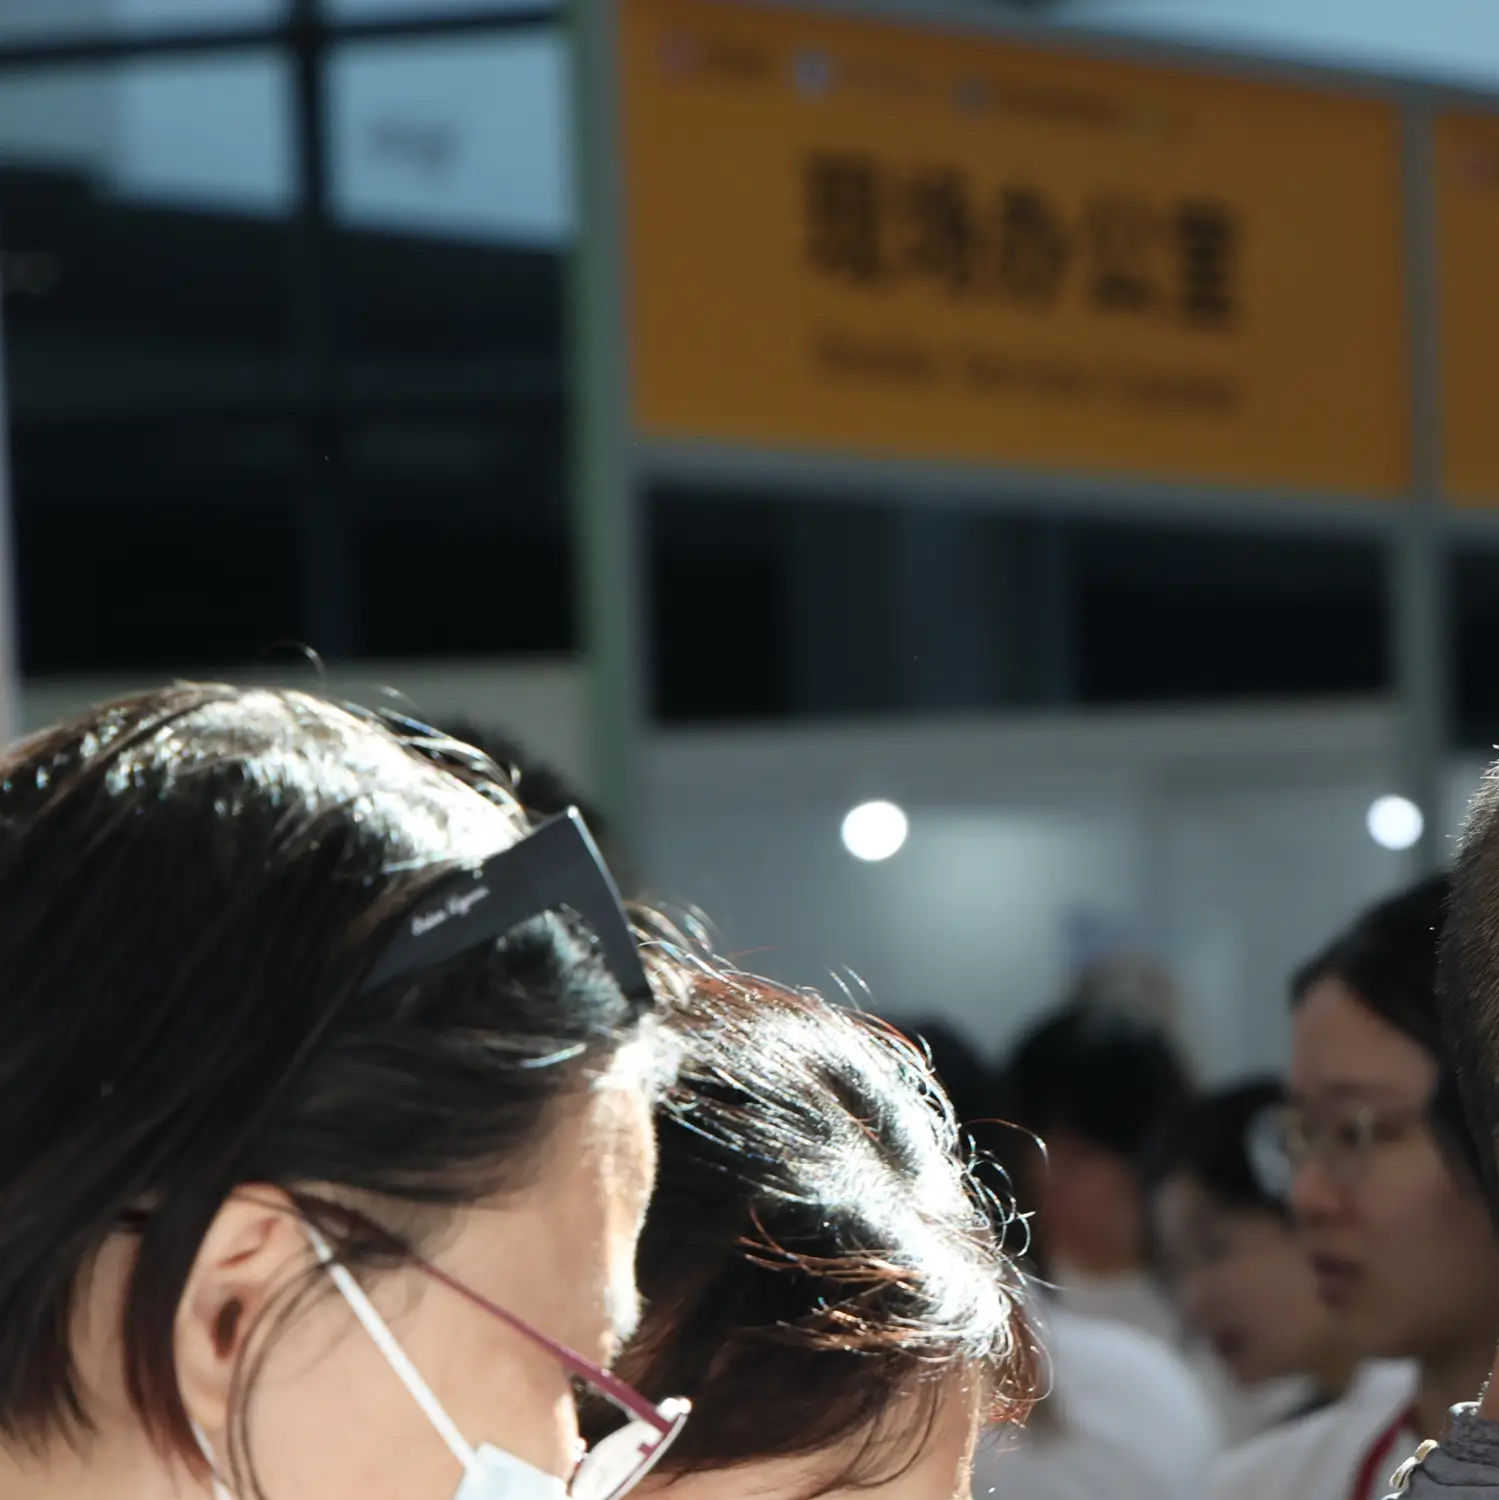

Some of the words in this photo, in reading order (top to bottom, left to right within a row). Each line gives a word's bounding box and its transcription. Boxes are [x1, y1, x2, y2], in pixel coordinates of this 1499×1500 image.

[803, 150, 1240, 332] 现场办公室
